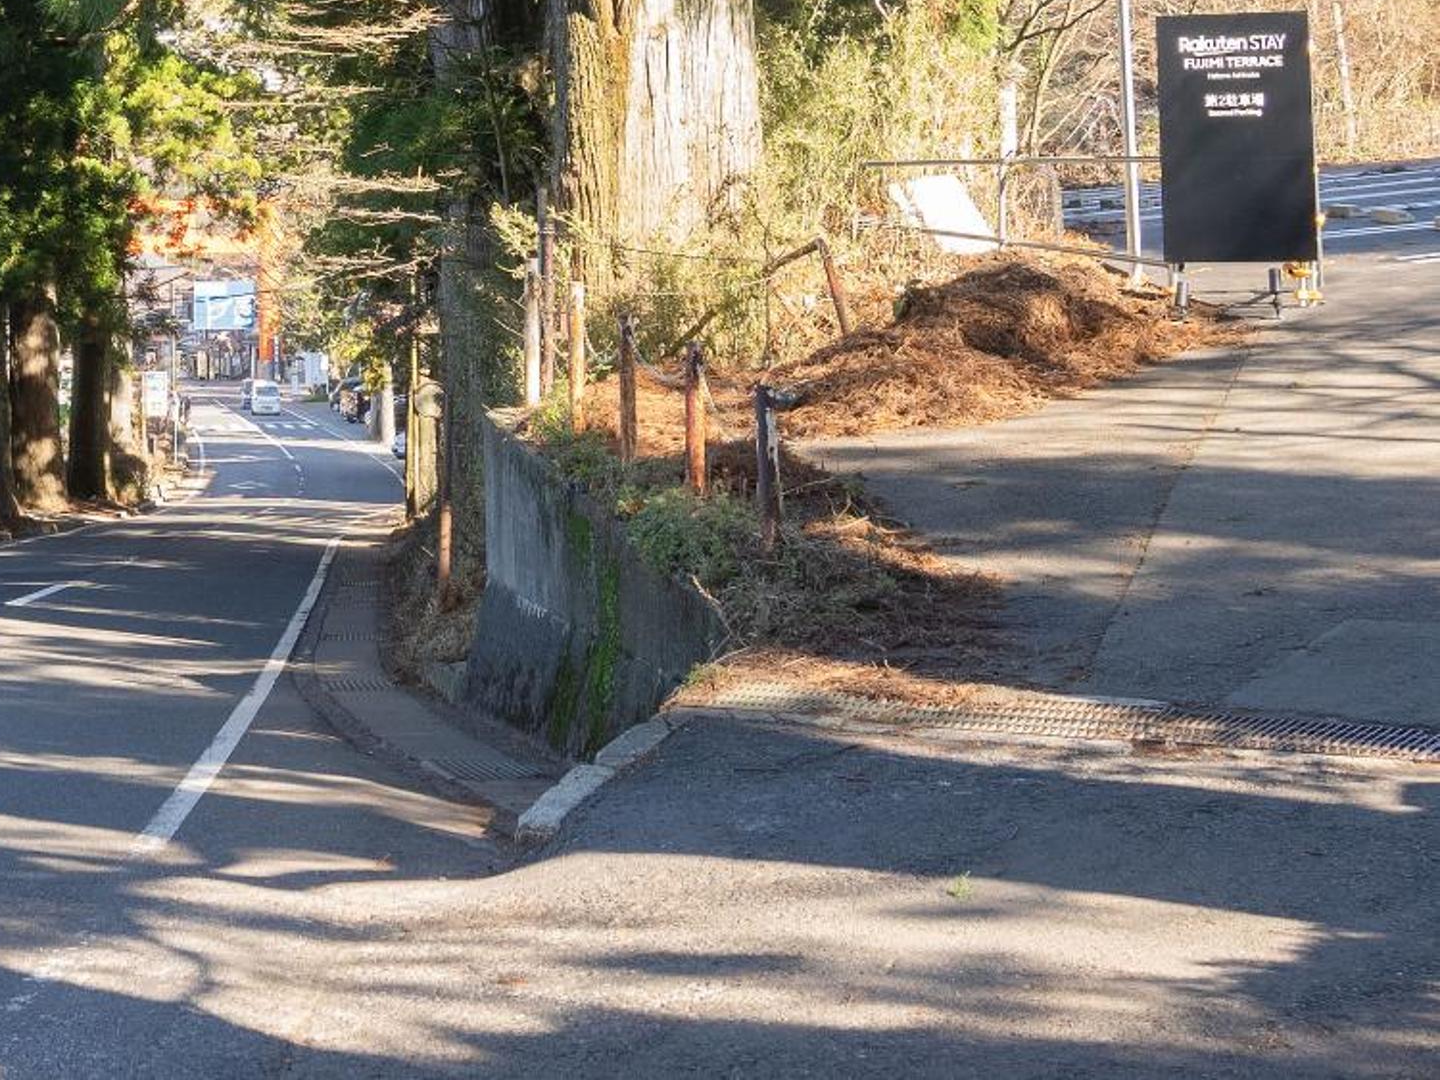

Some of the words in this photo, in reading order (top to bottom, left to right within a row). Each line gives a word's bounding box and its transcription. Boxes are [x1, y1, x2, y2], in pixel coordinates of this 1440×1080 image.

[1178, 35, 1248, 54] Rakuten
[1250, 34, 1286, 50] STAY
[1184, 57, 1224, 70] FUJIMI
[1226, 55, 1283, 68] TERRACE
